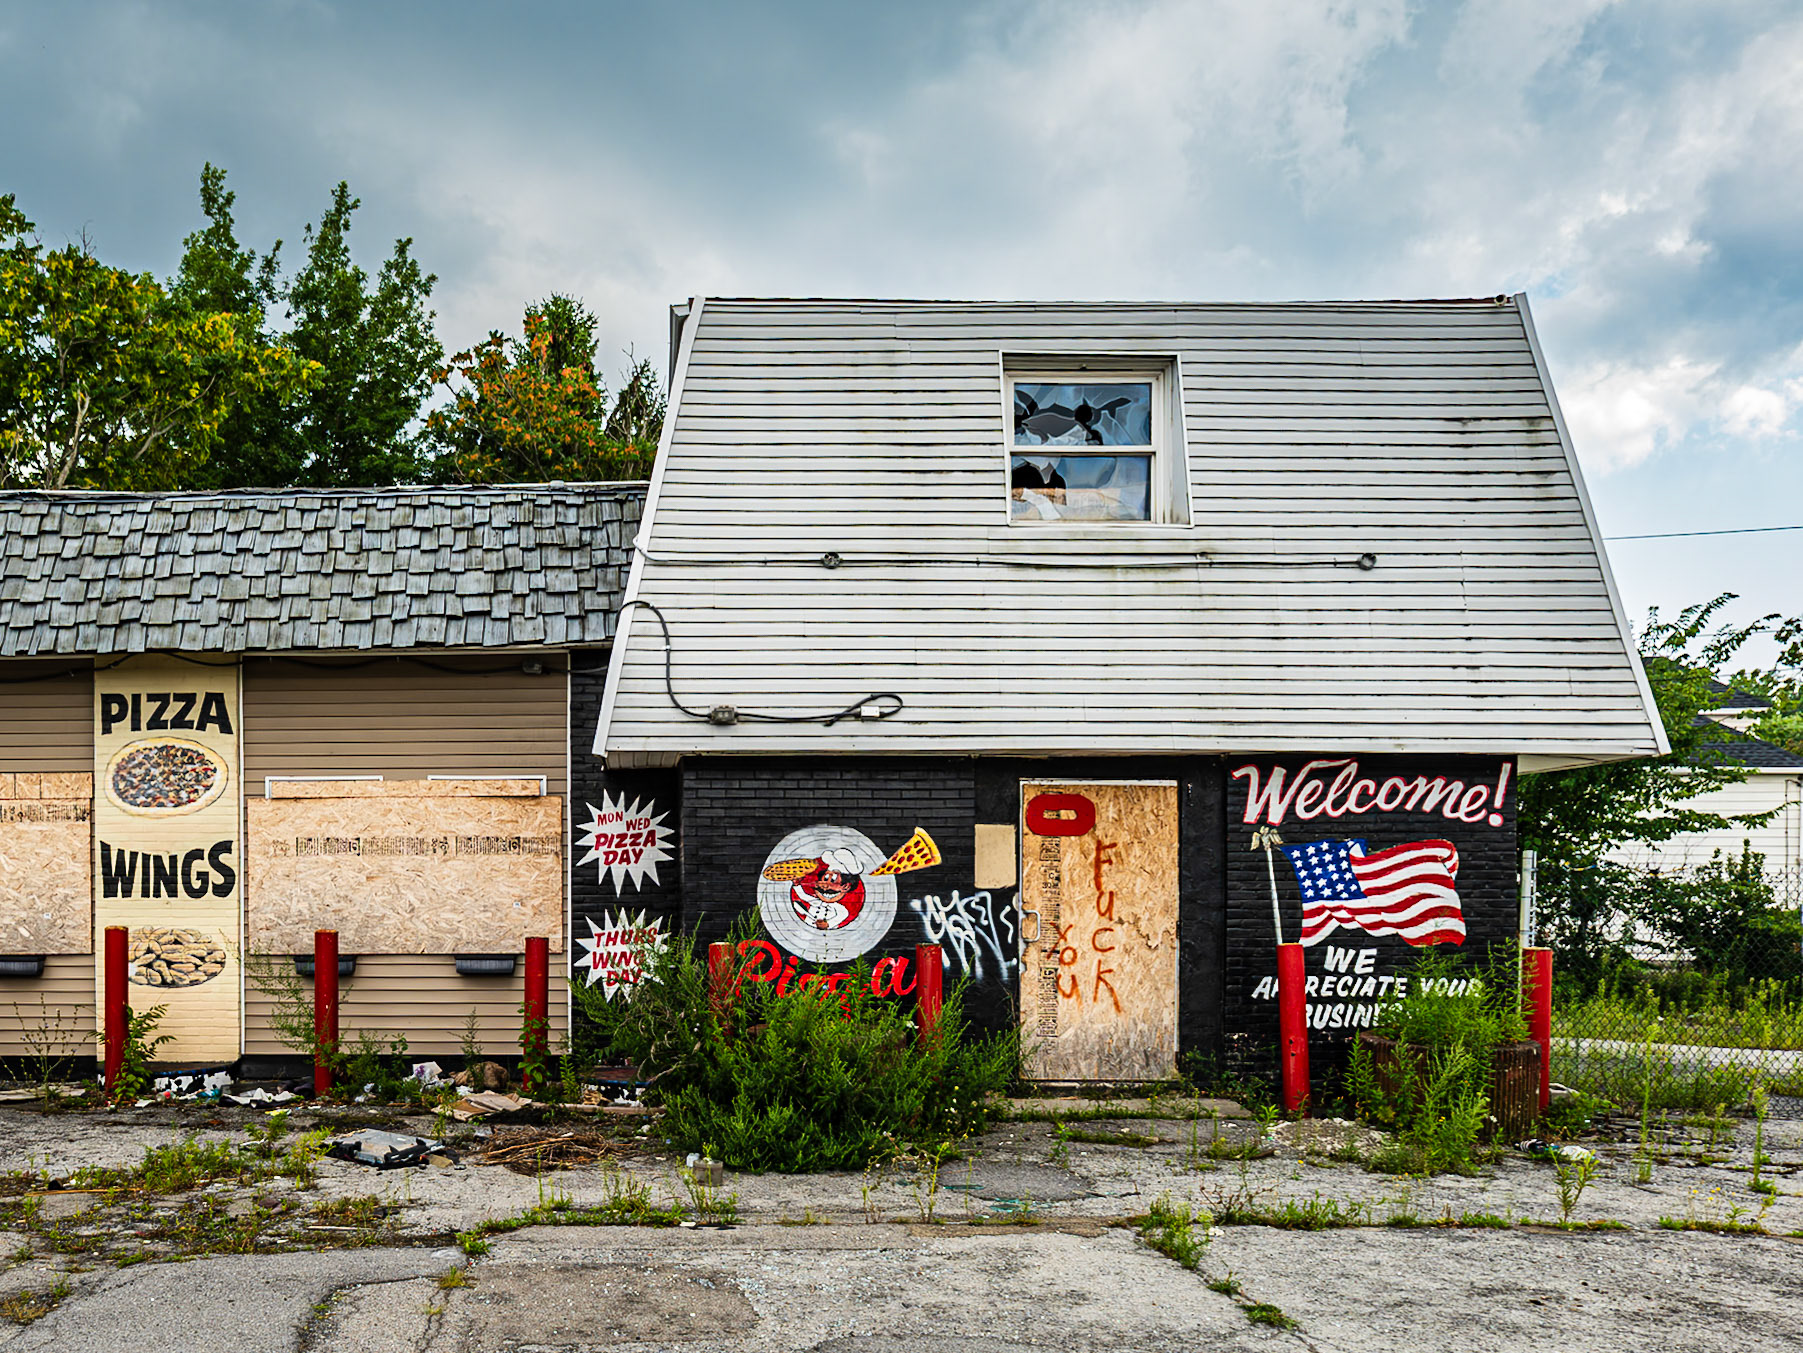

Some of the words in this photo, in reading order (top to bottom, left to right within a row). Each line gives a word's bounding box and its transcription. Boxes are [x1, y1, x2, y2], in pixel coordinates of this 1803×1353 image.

[100, 691, 235, 736] PIZZA
[1231, 757, 1512, 828] Welcome!
[597, 811, 624, 827] MON
[625, 817, 652, 832] WED
[594, 829, 657, 851] PIZZA
[602, 847, 644, 866] DAY
[99, 840, 236, 899] WINGS
[593, 927, 659, 948] THURS
[592, 949, 647, 970] WING
[1323, 945, 1378, 974] WE
[606, 968, 644, 987] DAY
[1250, 975, 1409, 1001] ARECIATE
[1419, 977, 1483, 999] YOUR
